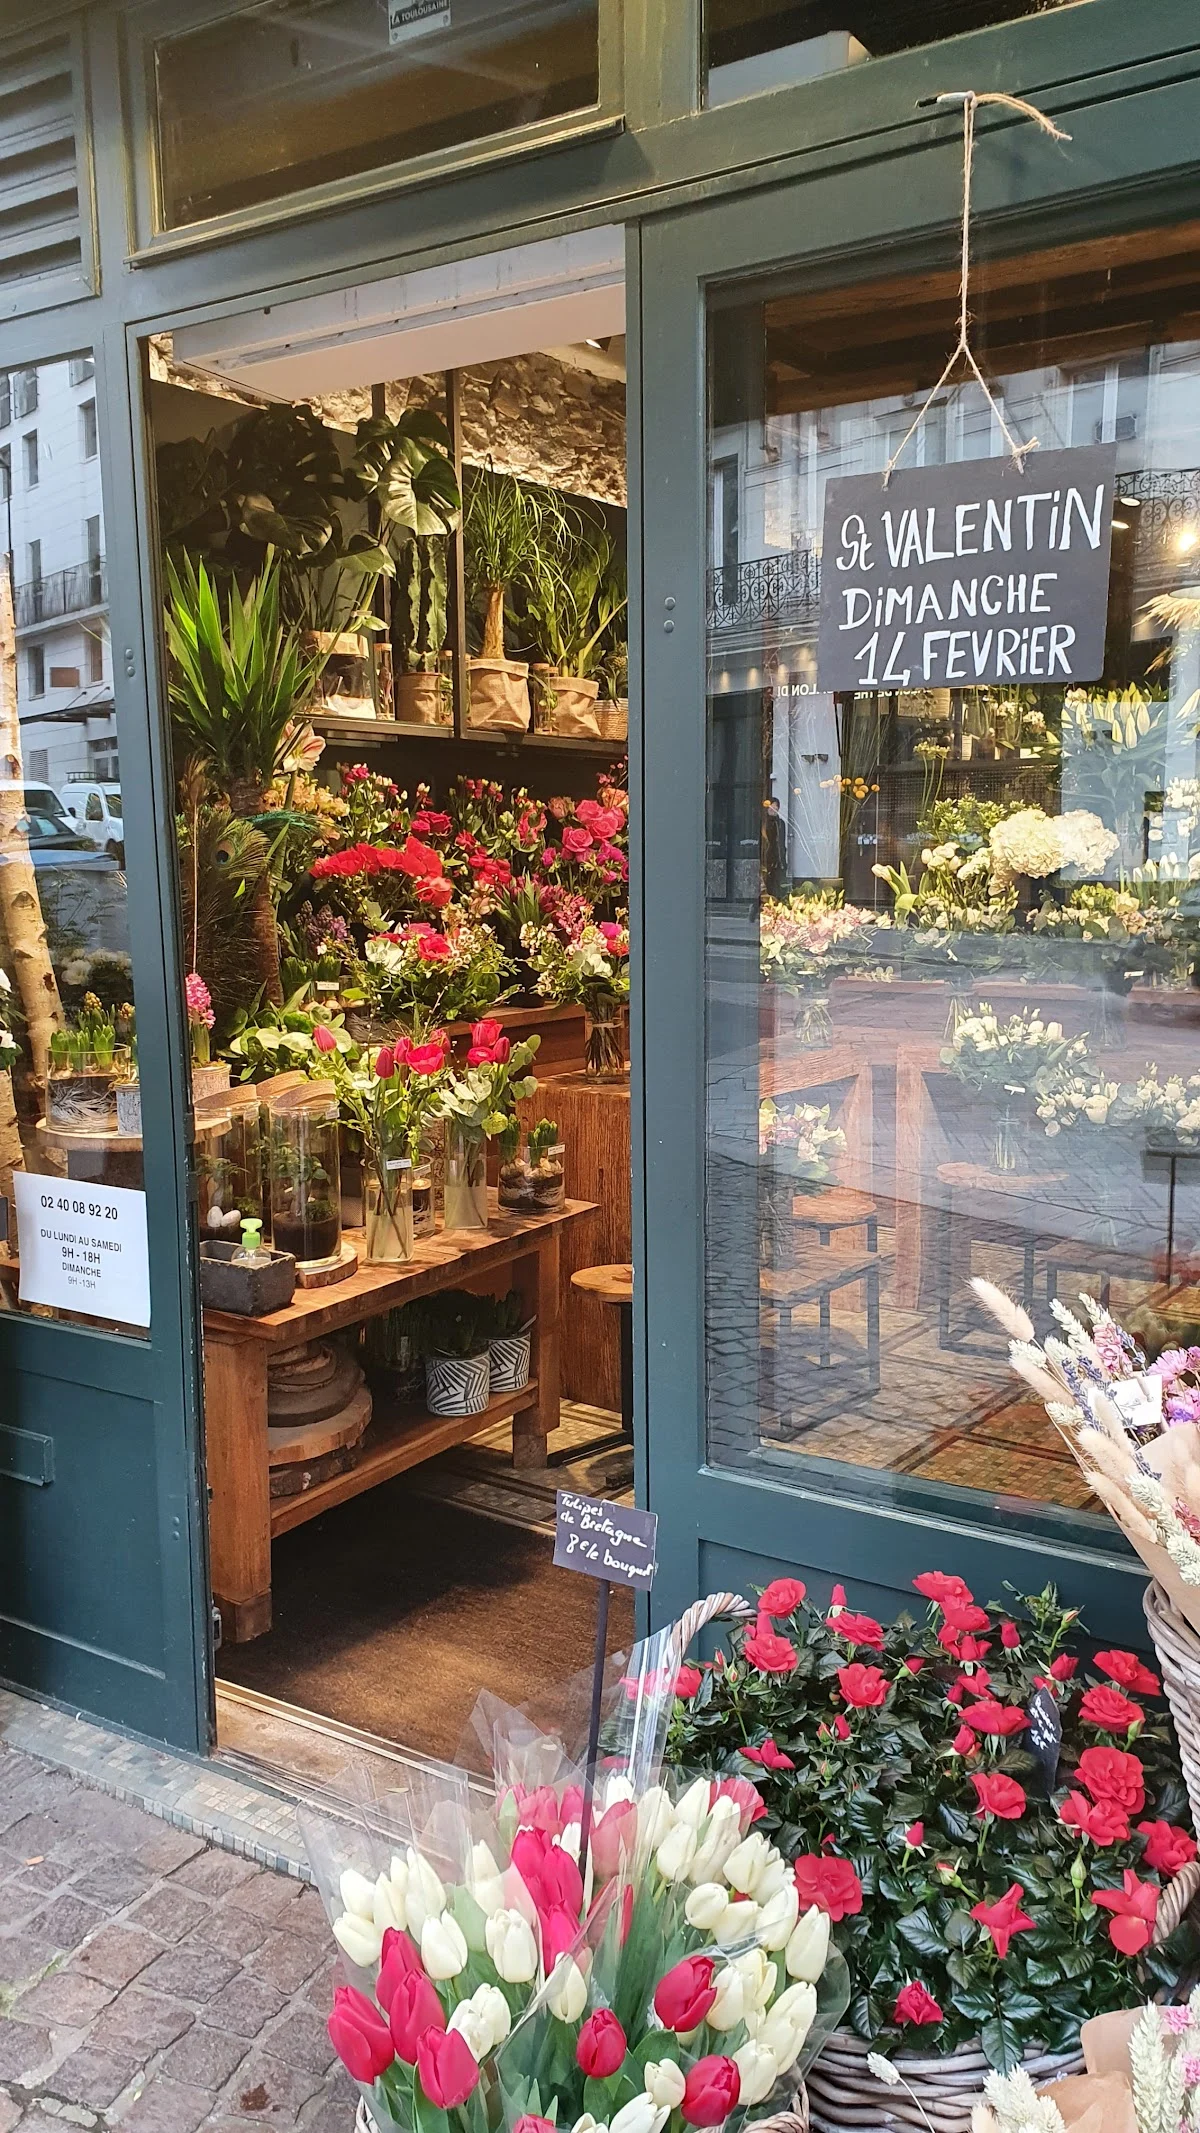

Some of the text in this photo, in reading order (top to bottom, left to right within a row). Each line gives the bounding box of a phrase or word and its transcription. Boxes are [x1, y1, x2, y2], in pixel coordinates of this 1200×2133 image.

[836, 514, 875, 571] St
[854, 631, 912, 686] 14
[40, 1195, 118, 1220] 02 40 08 92 20
[40, 1228, 122, 1253] DU LUNDI AU SAMEDI
[61, 1246, 74, 1259] 9H
[82, 1251, 101, 1264] 18H
[62, 1262, 101, 1278] DIMANCHE
[67, 1275, 78, 1285] 9H
[560, 1493, 603, 1517] Tulipes
[560, 1511, 648, 1548] de Bretagne
